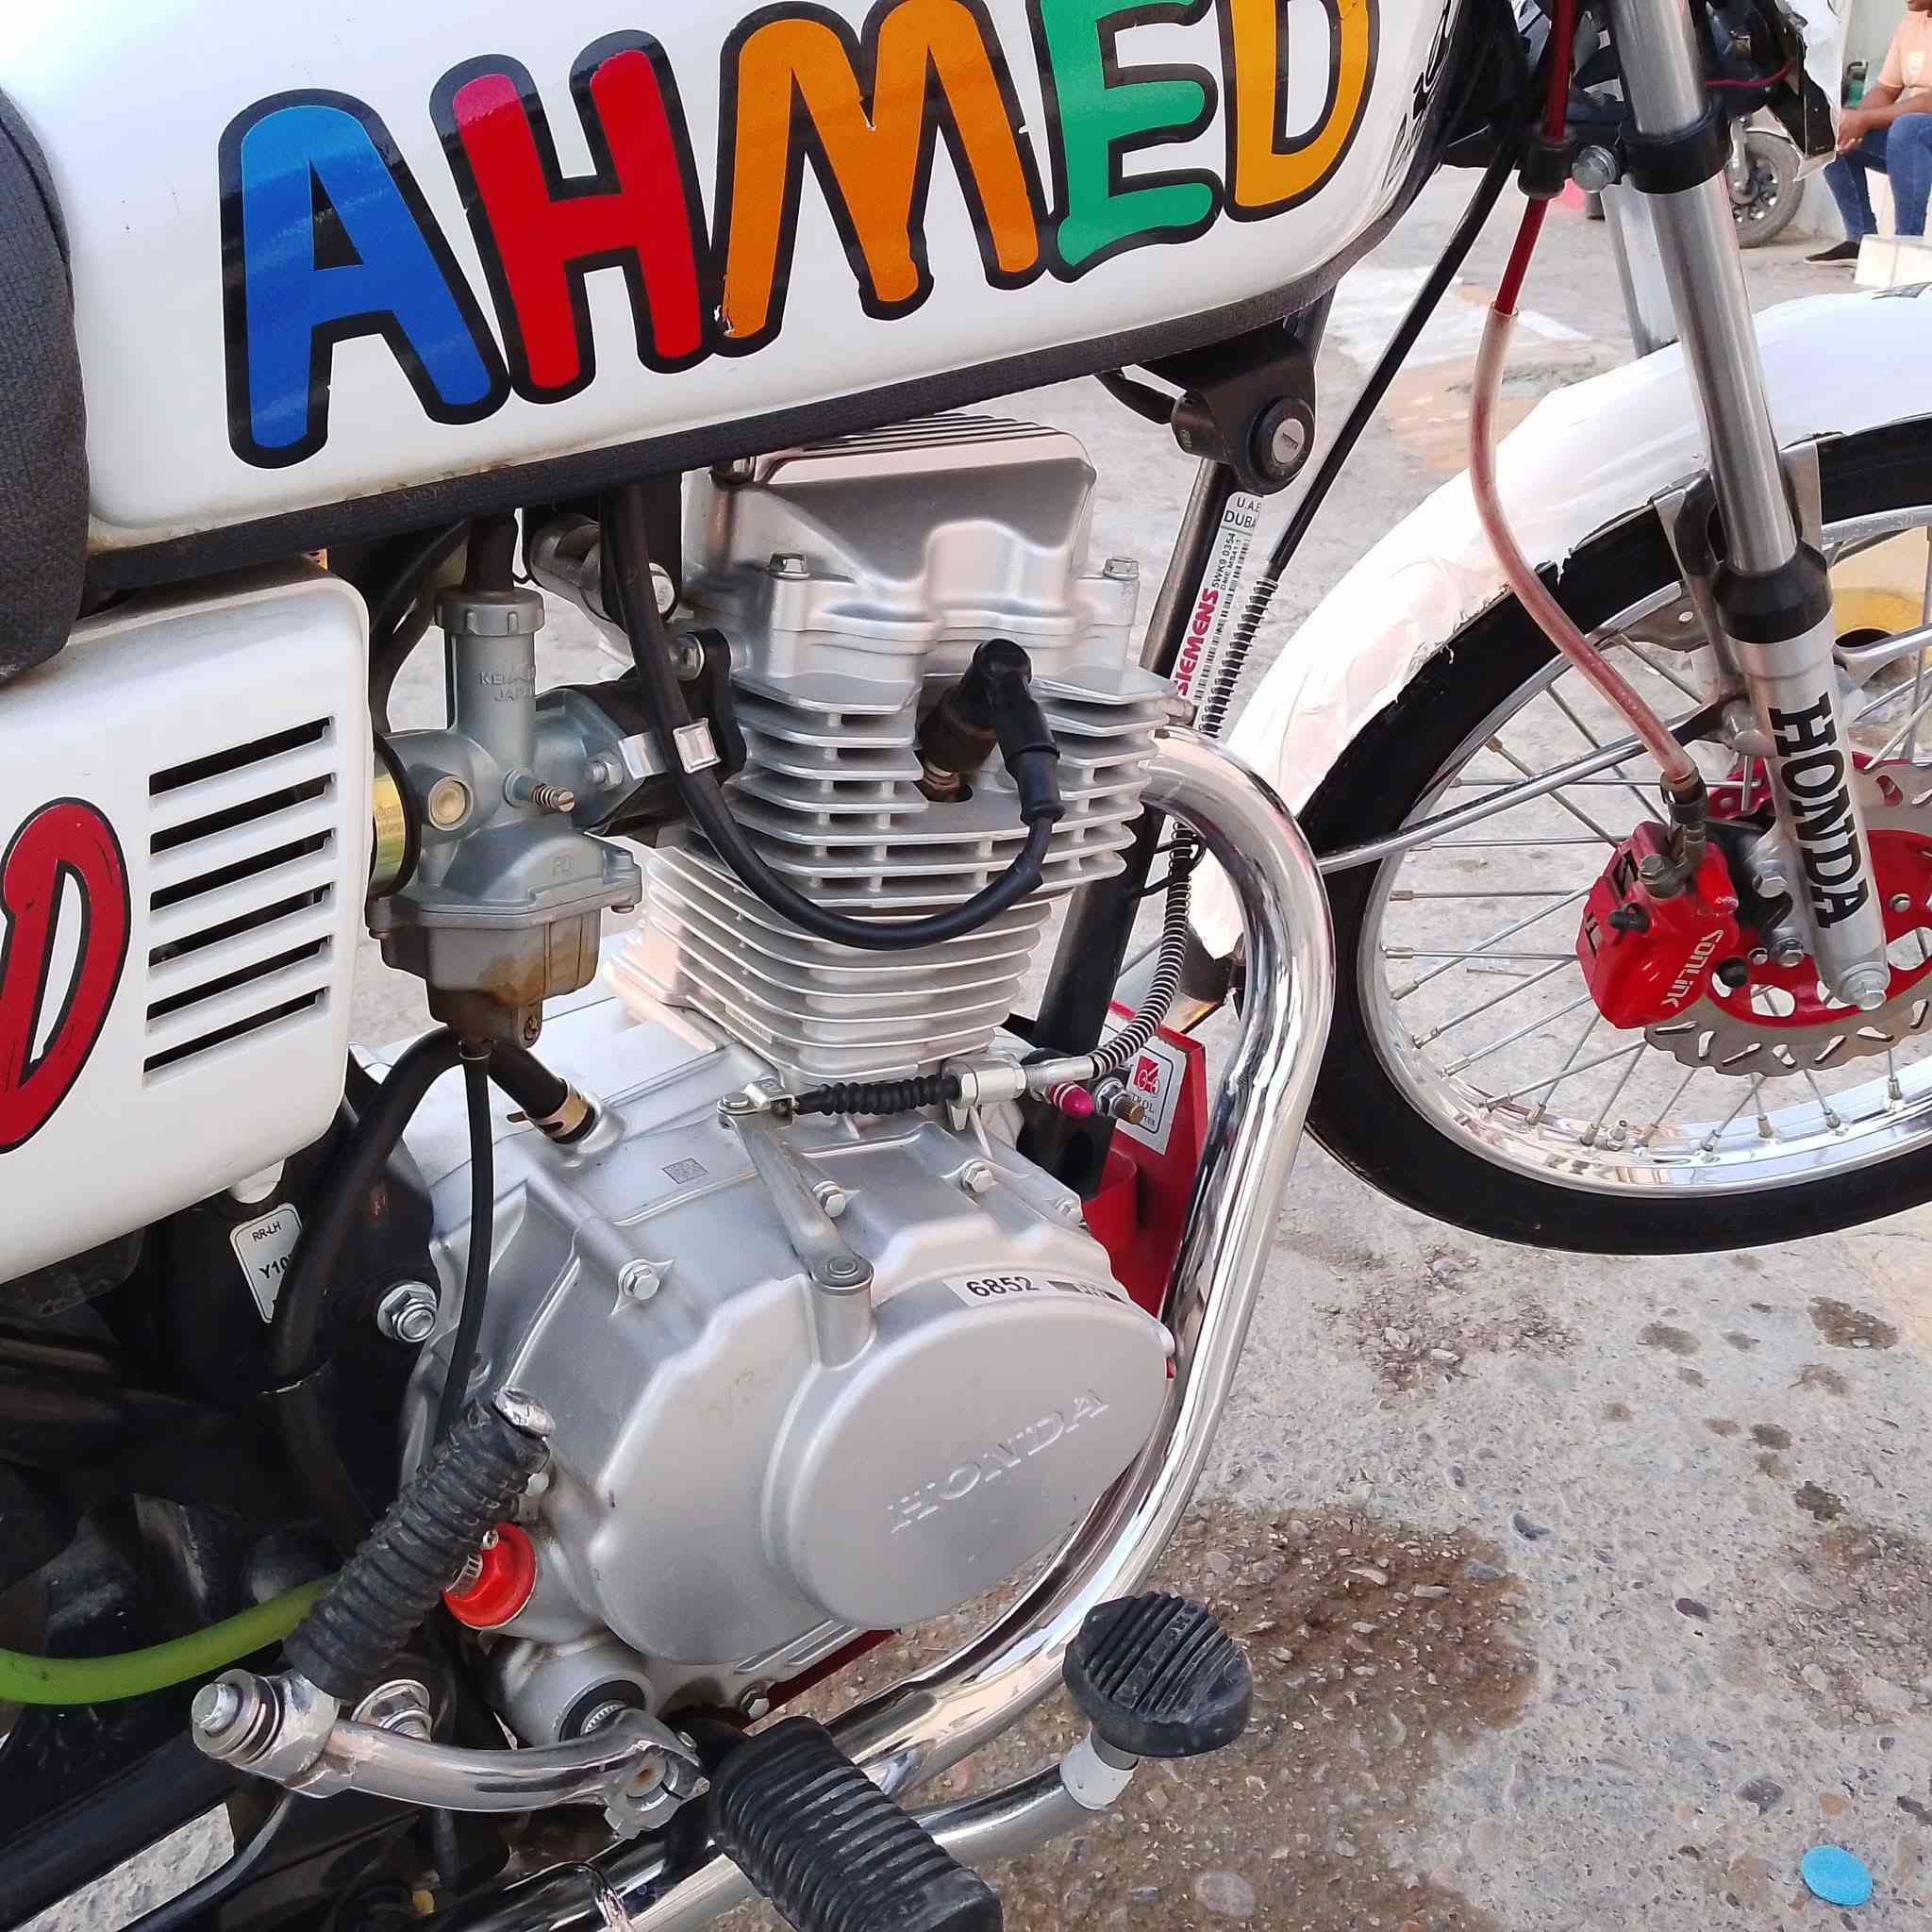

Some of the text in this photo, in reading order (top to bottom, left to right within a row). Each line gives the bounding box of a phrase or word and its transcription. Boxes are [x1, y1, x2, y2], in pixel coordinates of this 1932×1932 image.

[219, 0, 1379, 469] AHMED
[1175, 588, 1219, 696] SIEMENS
[1768, 691, 1871, 928] HONDA
[252, 1222, 282, 1242] RR-LH
[965, 1275, 1039, 1297] 6852
[887, 1389, 1108, 1534] HONDA
